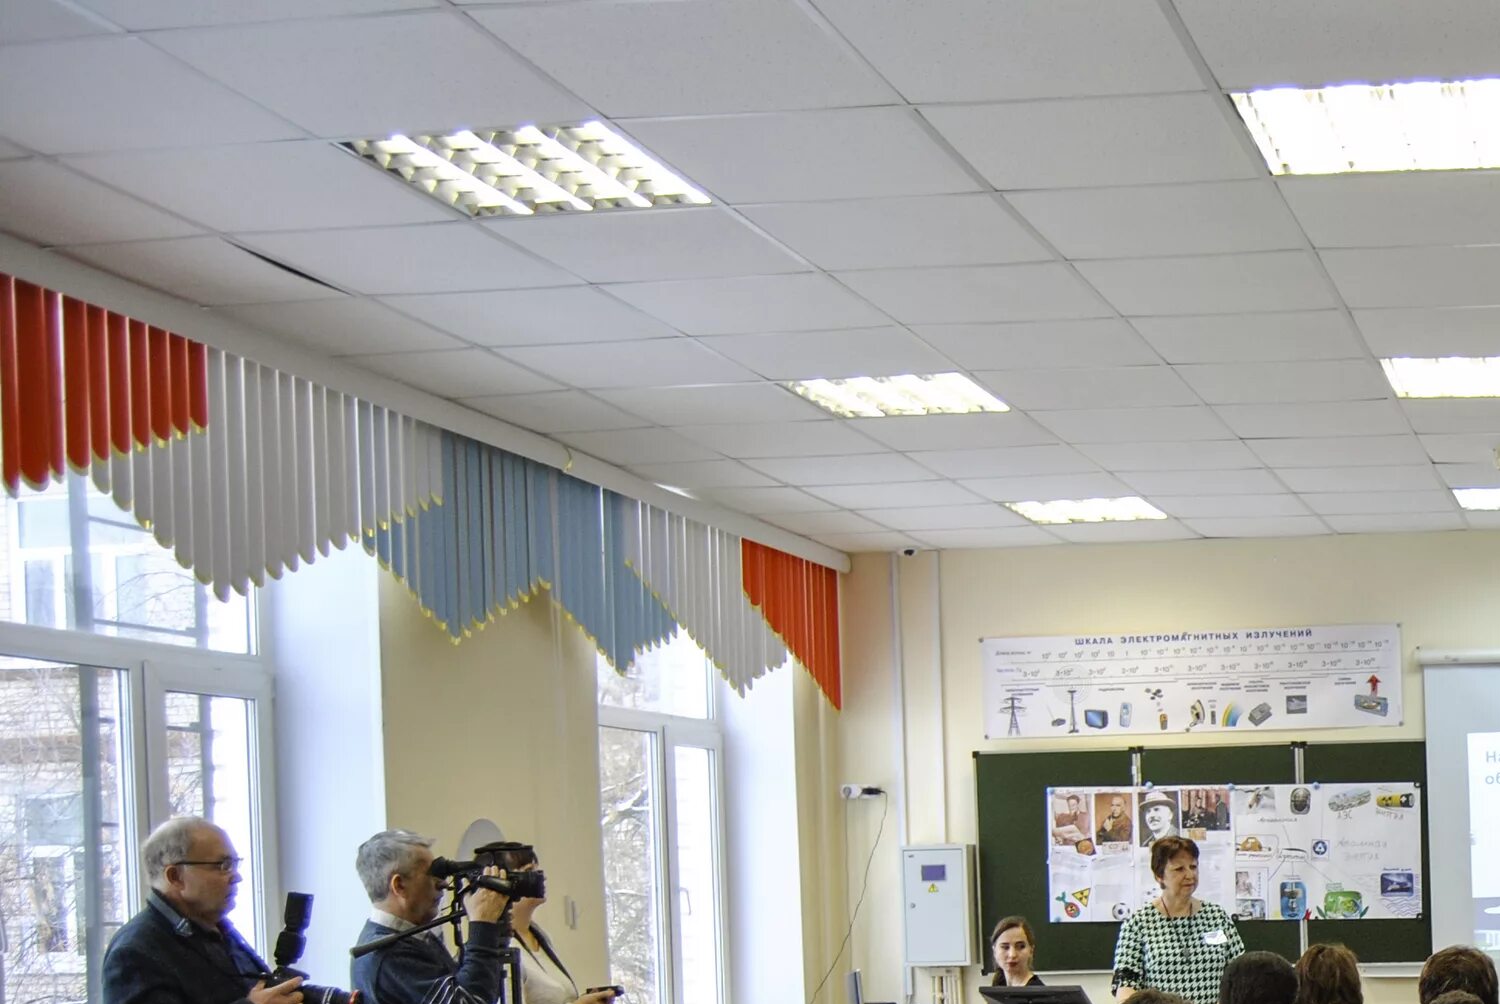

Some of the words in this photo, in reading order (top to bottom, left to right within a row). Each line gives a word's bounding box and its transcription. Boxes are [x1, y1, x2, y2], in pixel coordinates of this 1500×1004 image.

[1075, 635, 1114, 646] ШКАЛА
[1120, 632, 1239, 644] ЭЛЕКТРОМАГНИТНЫХ
[1246, 629, 1313, 639] ИЗЛУЧЕНИЙ
